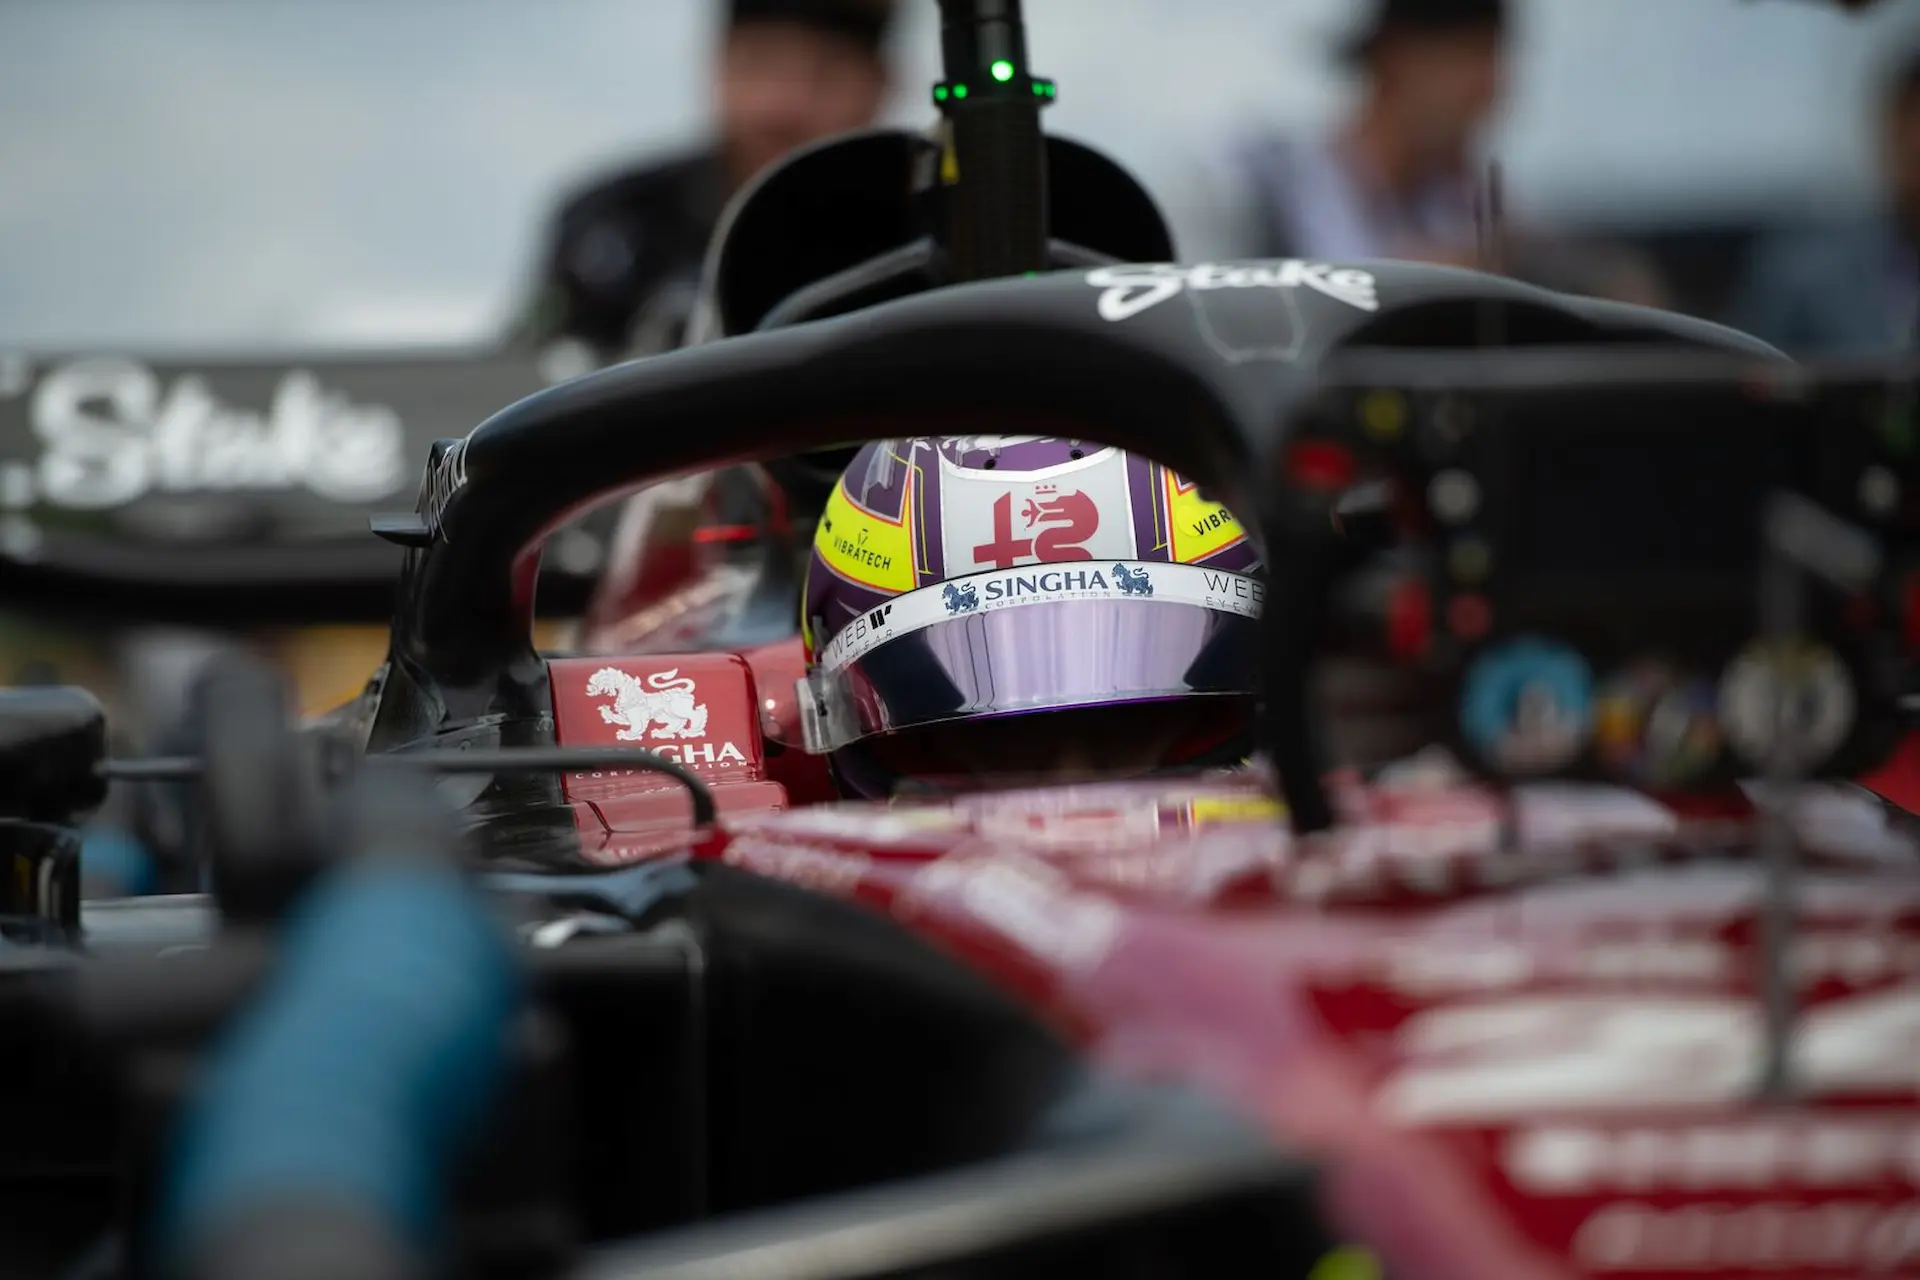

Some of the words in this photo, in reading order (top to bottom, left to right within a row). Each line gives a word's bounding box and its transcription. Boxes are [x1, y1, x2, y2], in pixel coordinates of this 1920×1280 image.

[1086, 260, 1380, 322] Stake
[1192, 509, 1233, 536] VIBR
[833, 535, 893, 571] VIBRATECH
[984, 571, 1109, 602] SINGHA
[575, 760, 749, 780] CORPTION
